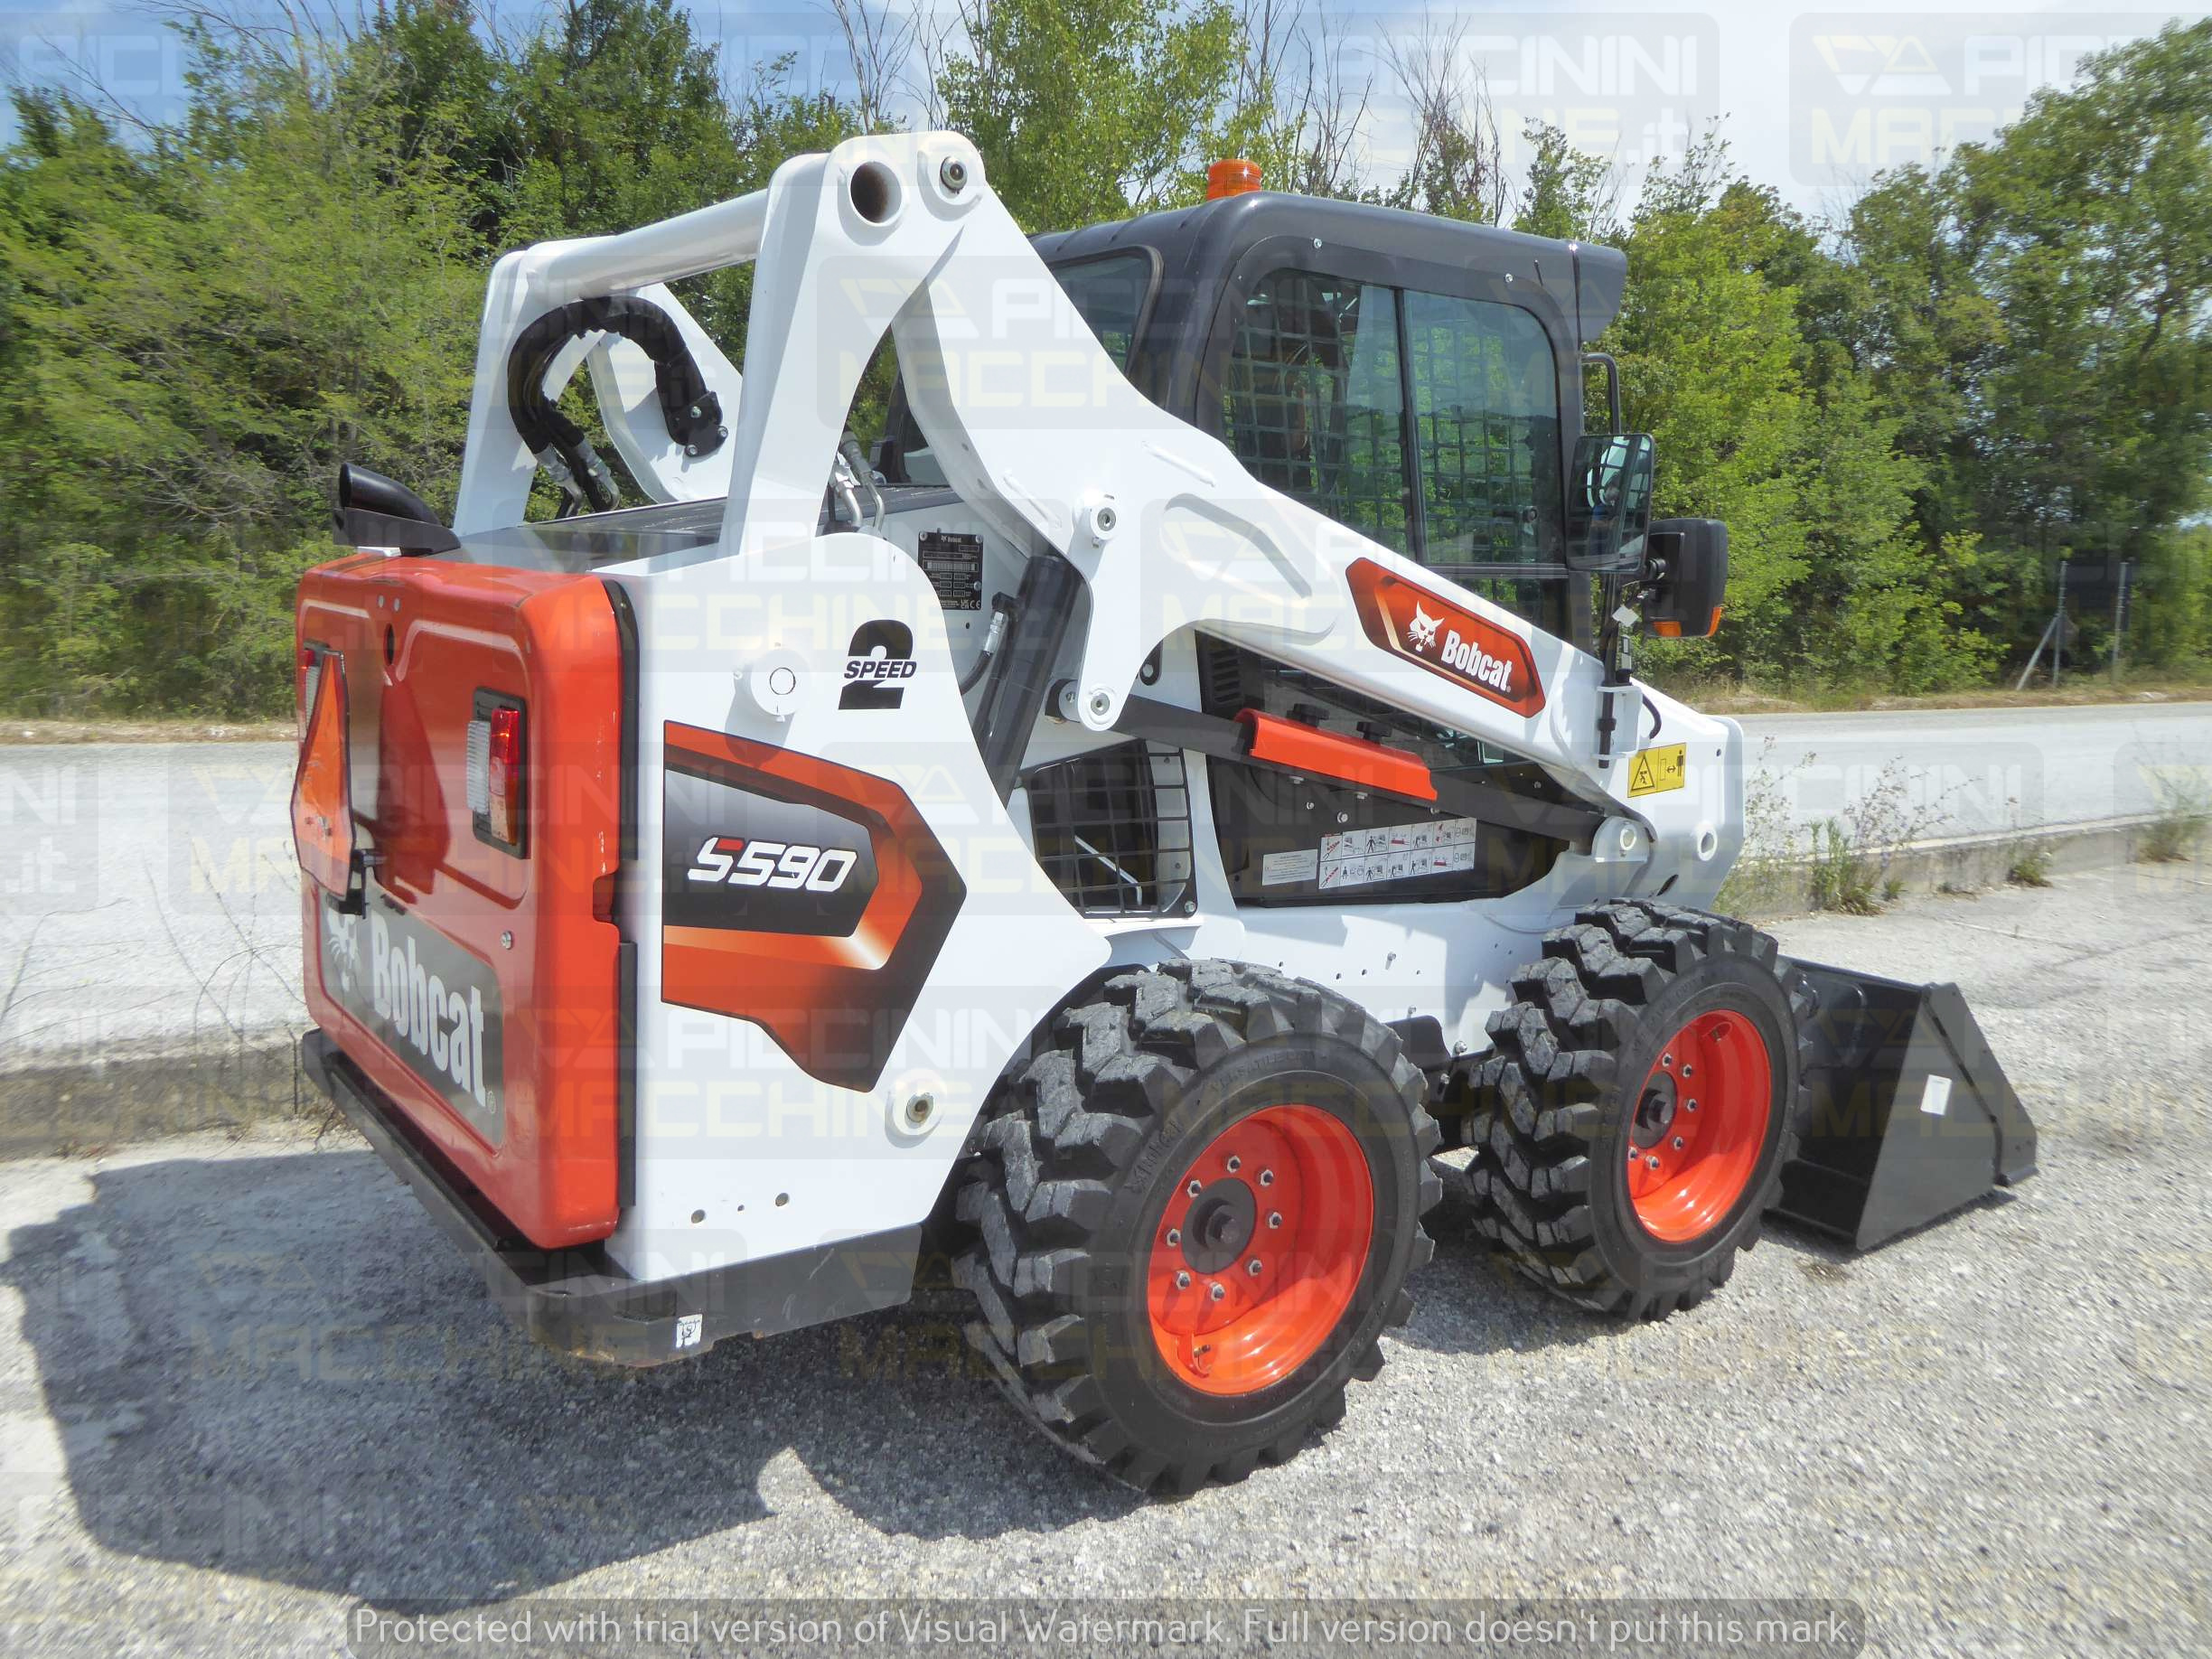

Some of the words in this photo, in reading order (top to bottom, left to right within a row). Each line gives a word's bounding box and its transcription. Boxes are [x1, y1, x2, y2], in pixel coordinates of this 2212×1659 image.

[838, 619, 913, 710] 2
[843, 660, 917, 679] SPEED
[1441, 630, 1512, 692] Bobcat
[687, 837, 858, 892] S590
[370, 908, 486, 1107] Bobcat
